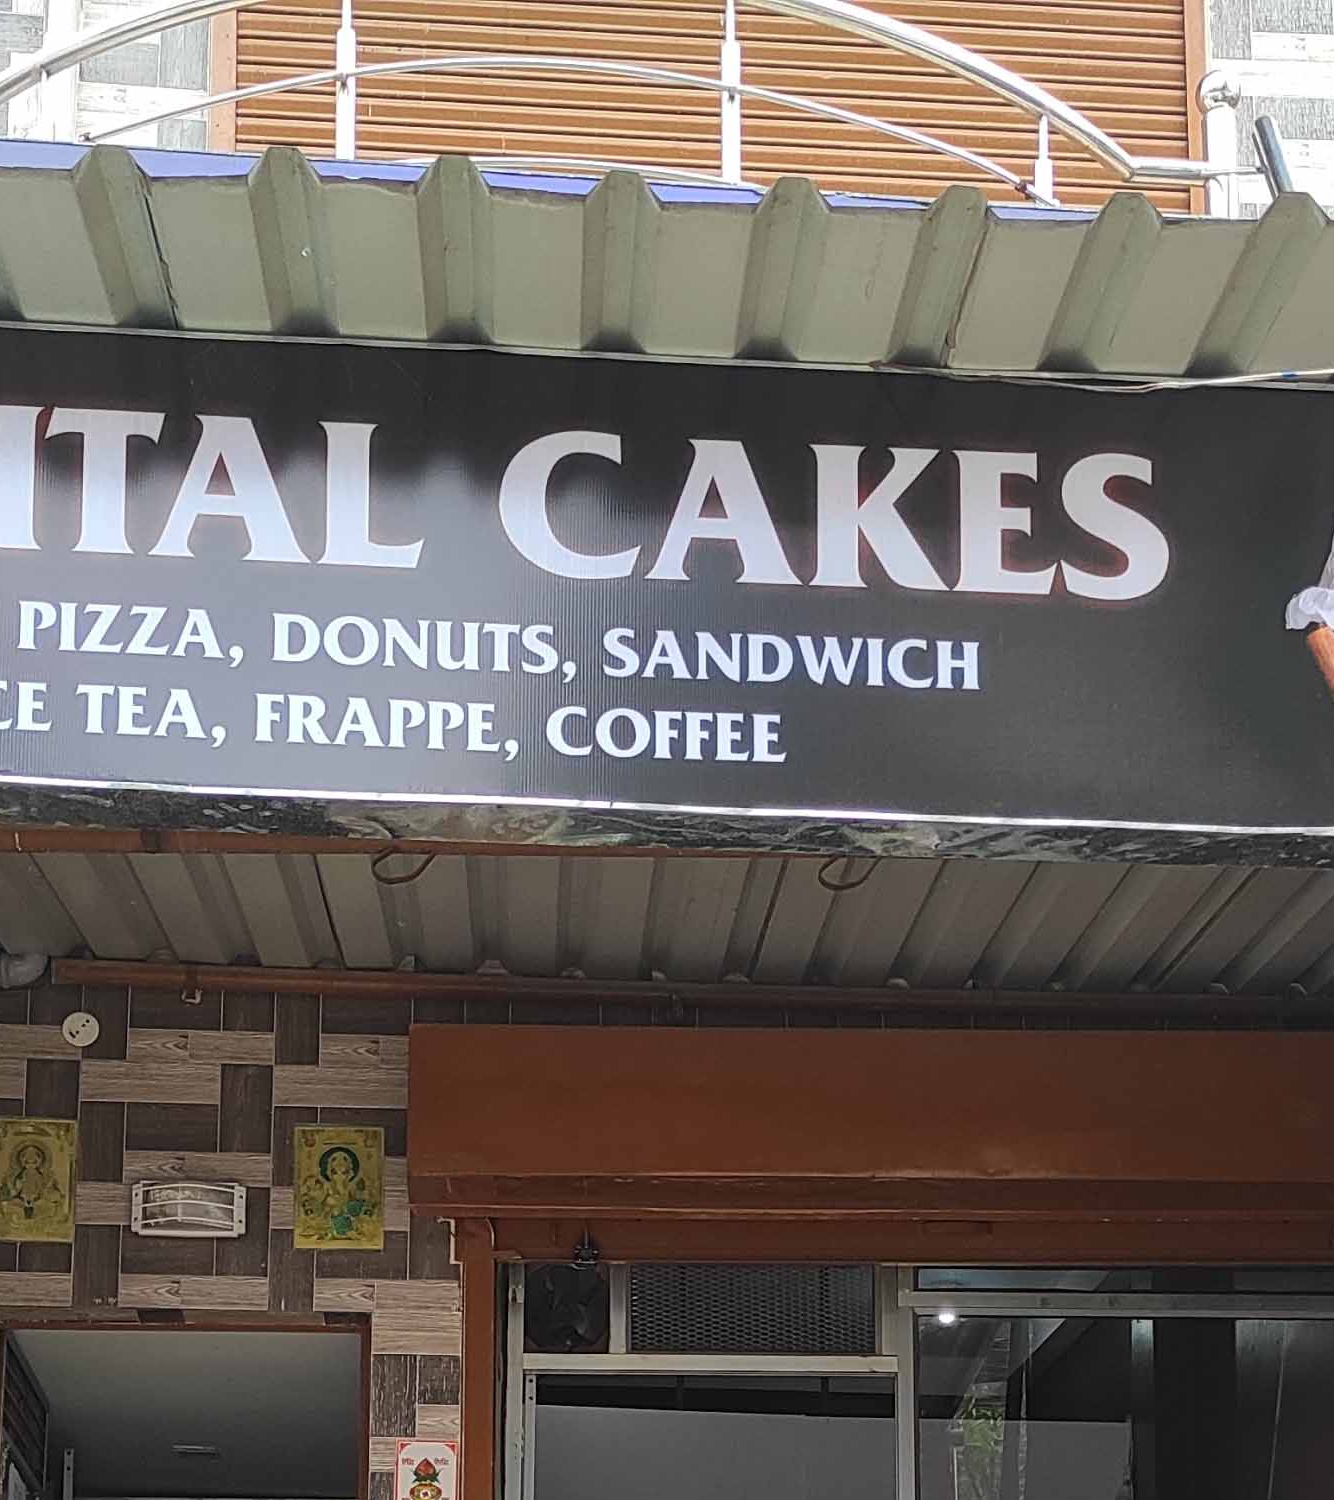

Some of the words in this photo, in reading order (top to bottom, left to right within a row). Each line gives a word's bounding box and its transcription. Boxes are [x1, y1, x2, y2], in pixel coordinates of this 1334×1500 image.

[498, 431, 1169, 600] CAKES
[16, 599, 244, 668] PIZZA,
[271, 612, 577, 683] DONUTS,
[602, 627, 980, 690] SANDWICH
[75, 683, 227, 748] TEA,
[254, 692, 519, 761] FRAPPE,
[546, 705, 786, 763] COFFEE
